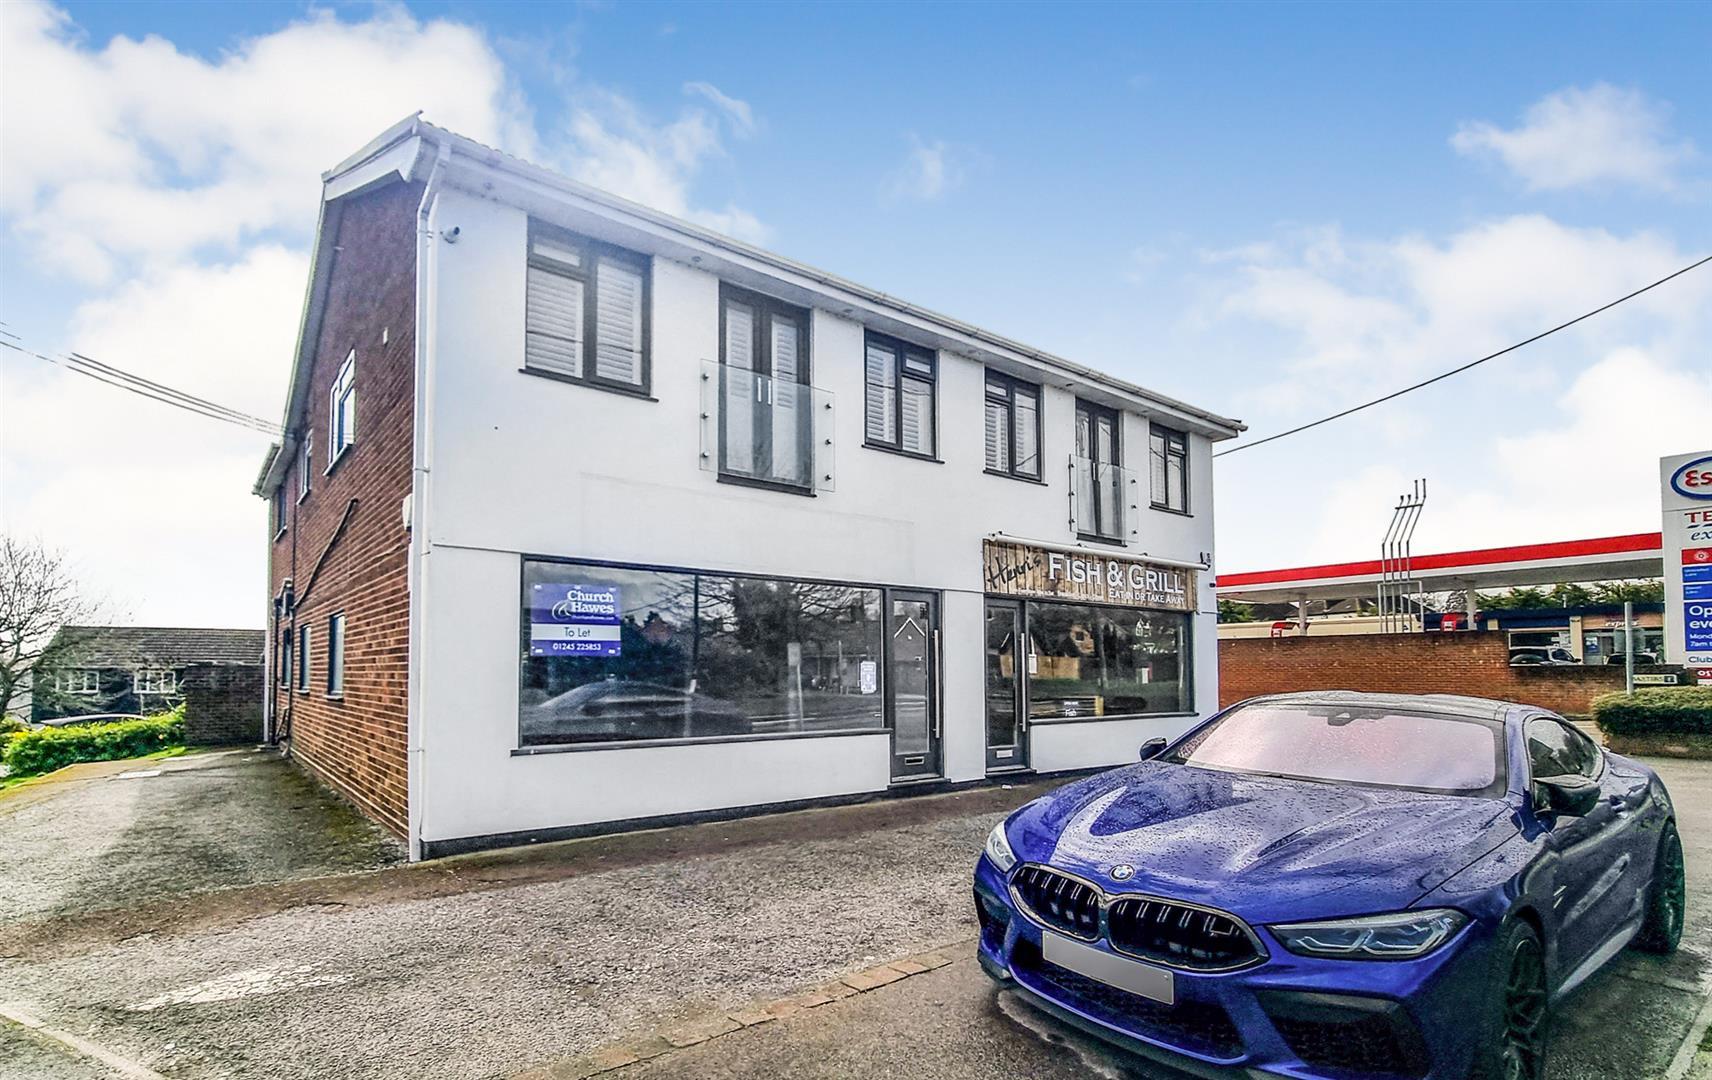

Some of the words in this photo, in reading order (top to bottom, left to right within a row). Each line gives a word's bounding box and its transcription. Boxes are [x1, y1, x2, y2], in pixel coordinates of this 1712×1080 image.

[1048, 552, 1101, 585] FISH
[1107, 560, 1123, 587] &
[1128, 564, 1185, 594] GRILL
[567, 590, 615, 603] Church
[1108, 588, 1124, 600] EAT
[1135, 592, 1146, 602] OR
[1146, 592, 1165, 603] TAKE
[1165, 595, 1185, 605] AWAY
[571, 602, 615, 614] Hawes
[564, 627, 575, 637] To
[578, 627, 591, 637] Let
[552, 643, 575, 651] 01245
